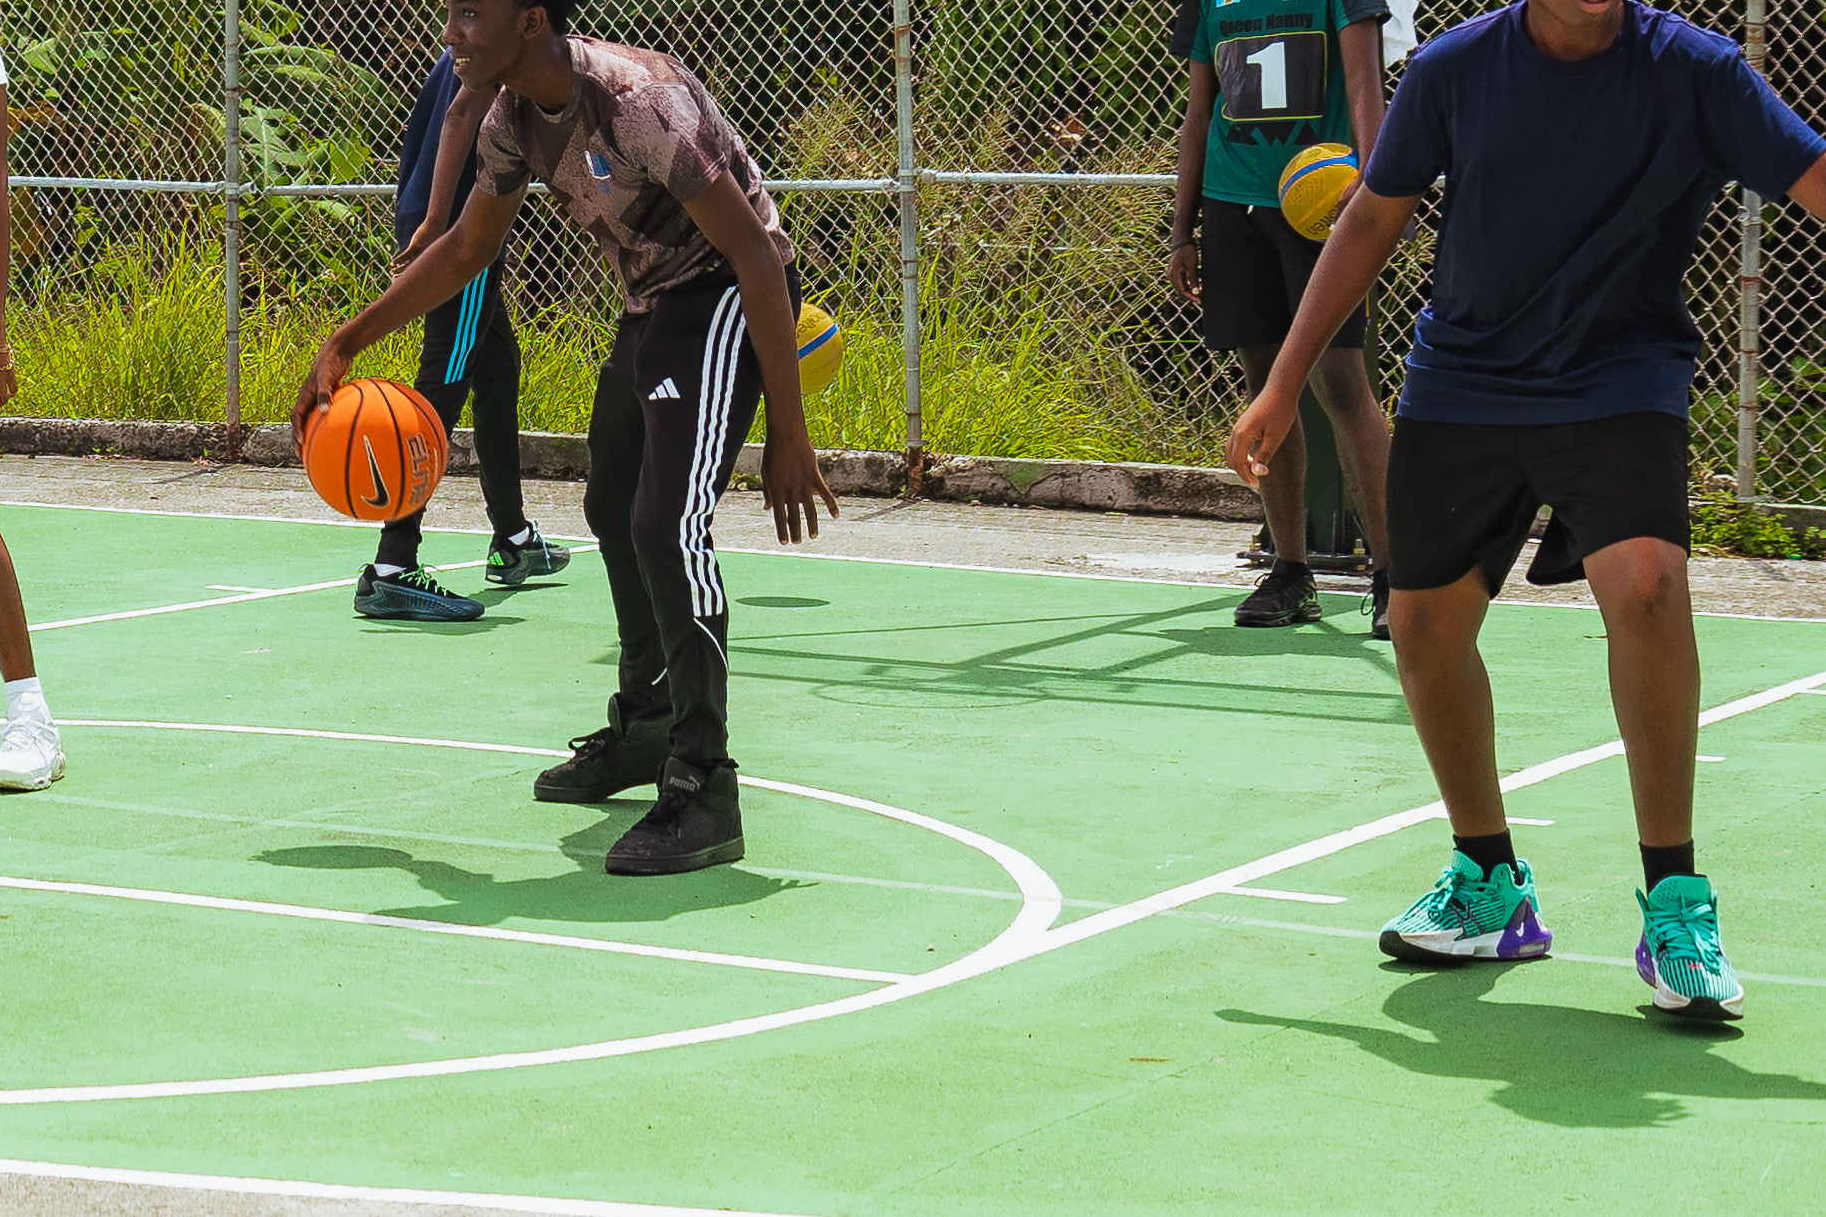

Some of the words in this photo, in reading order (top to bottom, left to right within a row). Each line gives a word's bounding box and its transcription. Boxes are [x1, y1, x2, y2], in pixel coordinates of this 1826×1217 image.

[1219, 17, 1264, 37] Queen
[1265, 13, 1314, 30] Nanny
[1245, 41, 1287, 110] 1
[1305, 205, 1339, 236] olten
[669, 775, 696, 792] PUMA
